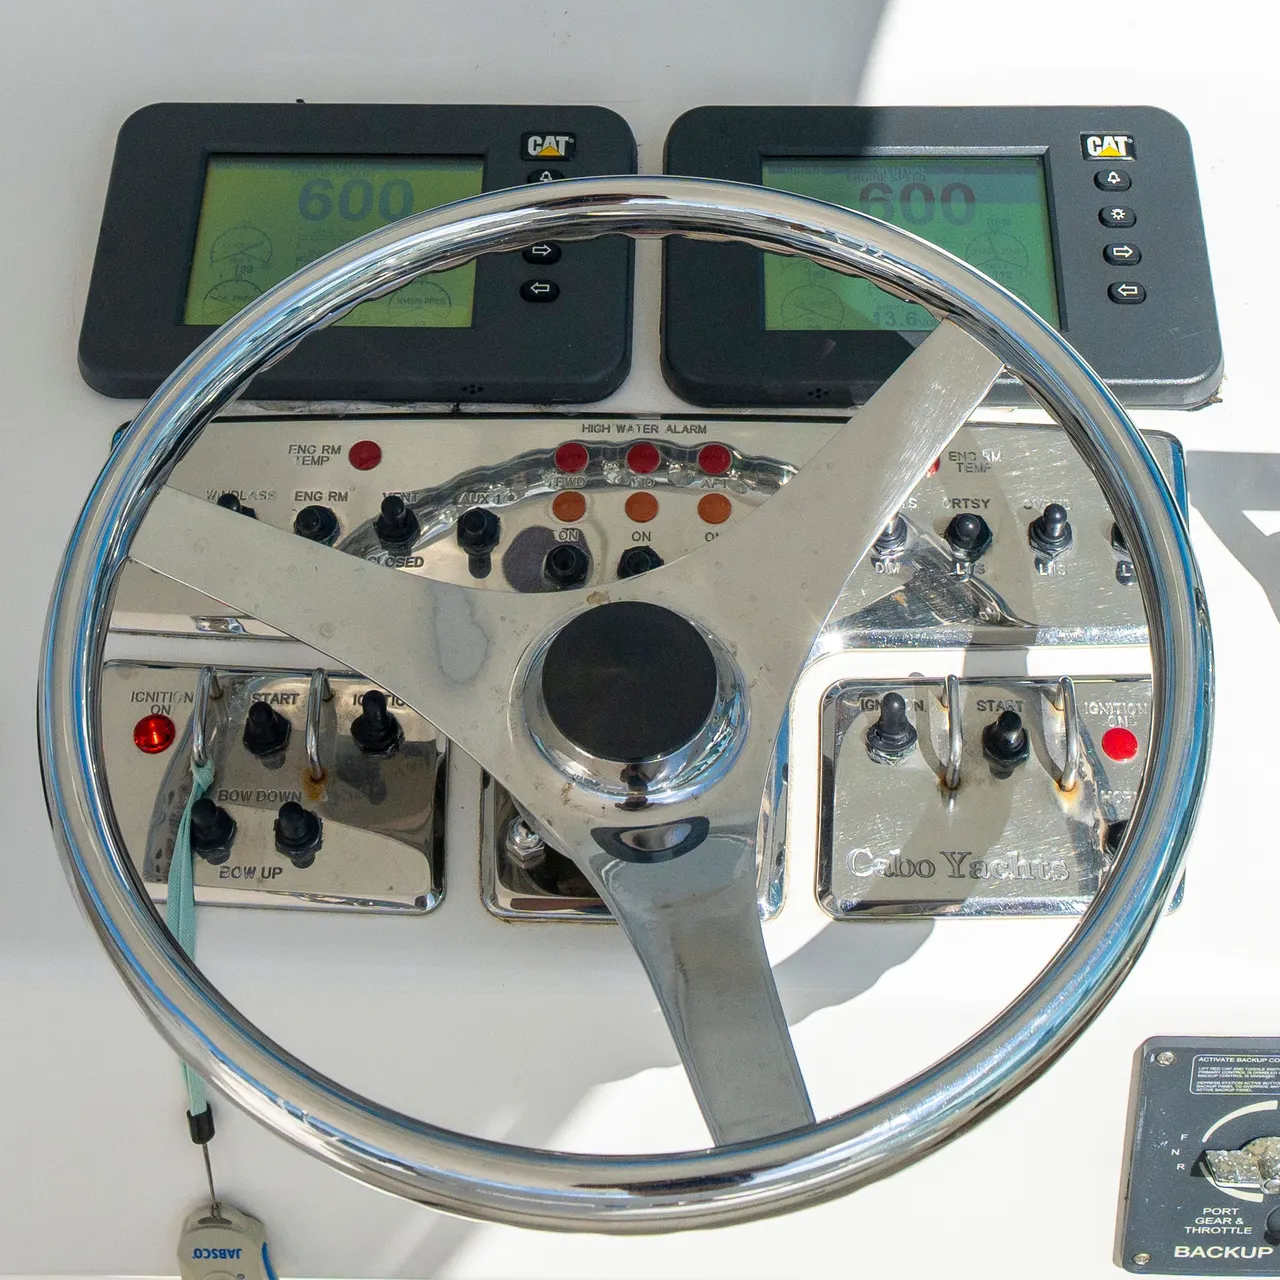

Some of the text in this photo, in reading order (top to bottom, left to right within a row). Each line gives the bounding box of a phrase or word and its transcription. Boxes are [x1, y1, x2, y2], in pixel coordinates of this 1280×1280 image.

[528, 136, 570, 156] CAT
[1087, 136, 1128, 156] CAT
[298, 178, 415, 221] 600
[859, 182, 976, 226] 600
[582, 424, 707, 434] HIGH WATER ALARM
[288, 445, 342, 455] ENG RM
[949, 450, 1002, 463] ENG RM
[956, 462, 992, 473] TEMP
[294, 491, 349, 502] ENG RM
[458, 493, 489, 504] AUX
[942, 498, 991, 509] CRTSY
[558, 530, 579, 542] ON
[631, 531, 651, 542] ON
[875, 563, 900, 574] DIM
[957, 563, 986, 575] LTS
[1039, 564, 1068, 576] LTS
[131, 691, 194, 703] IGNITION
[251, 693, 300, 705] START
[150, 704, 171, 715] ON
[976, 699, 1024, 712] START
[1084, 701, 1148, 716] IGNITION
[1107, 715, 1129, 727] ON
[218, 789, 302, 802] BOW DOWN
[846, 848, 1070, 881] Cabo Yachts
[219, 866, 283, 880] BOW UP
[1203, 1208, 1239, 1216] PORT
[1195, 1217, 1232, 1225] GEAR
[1184, 1227, 1252, 1235] THROTTLE
[192, 1248, 242, 1259] JABSCO
[1174, 1246, 1274, 1259] BACKUP
